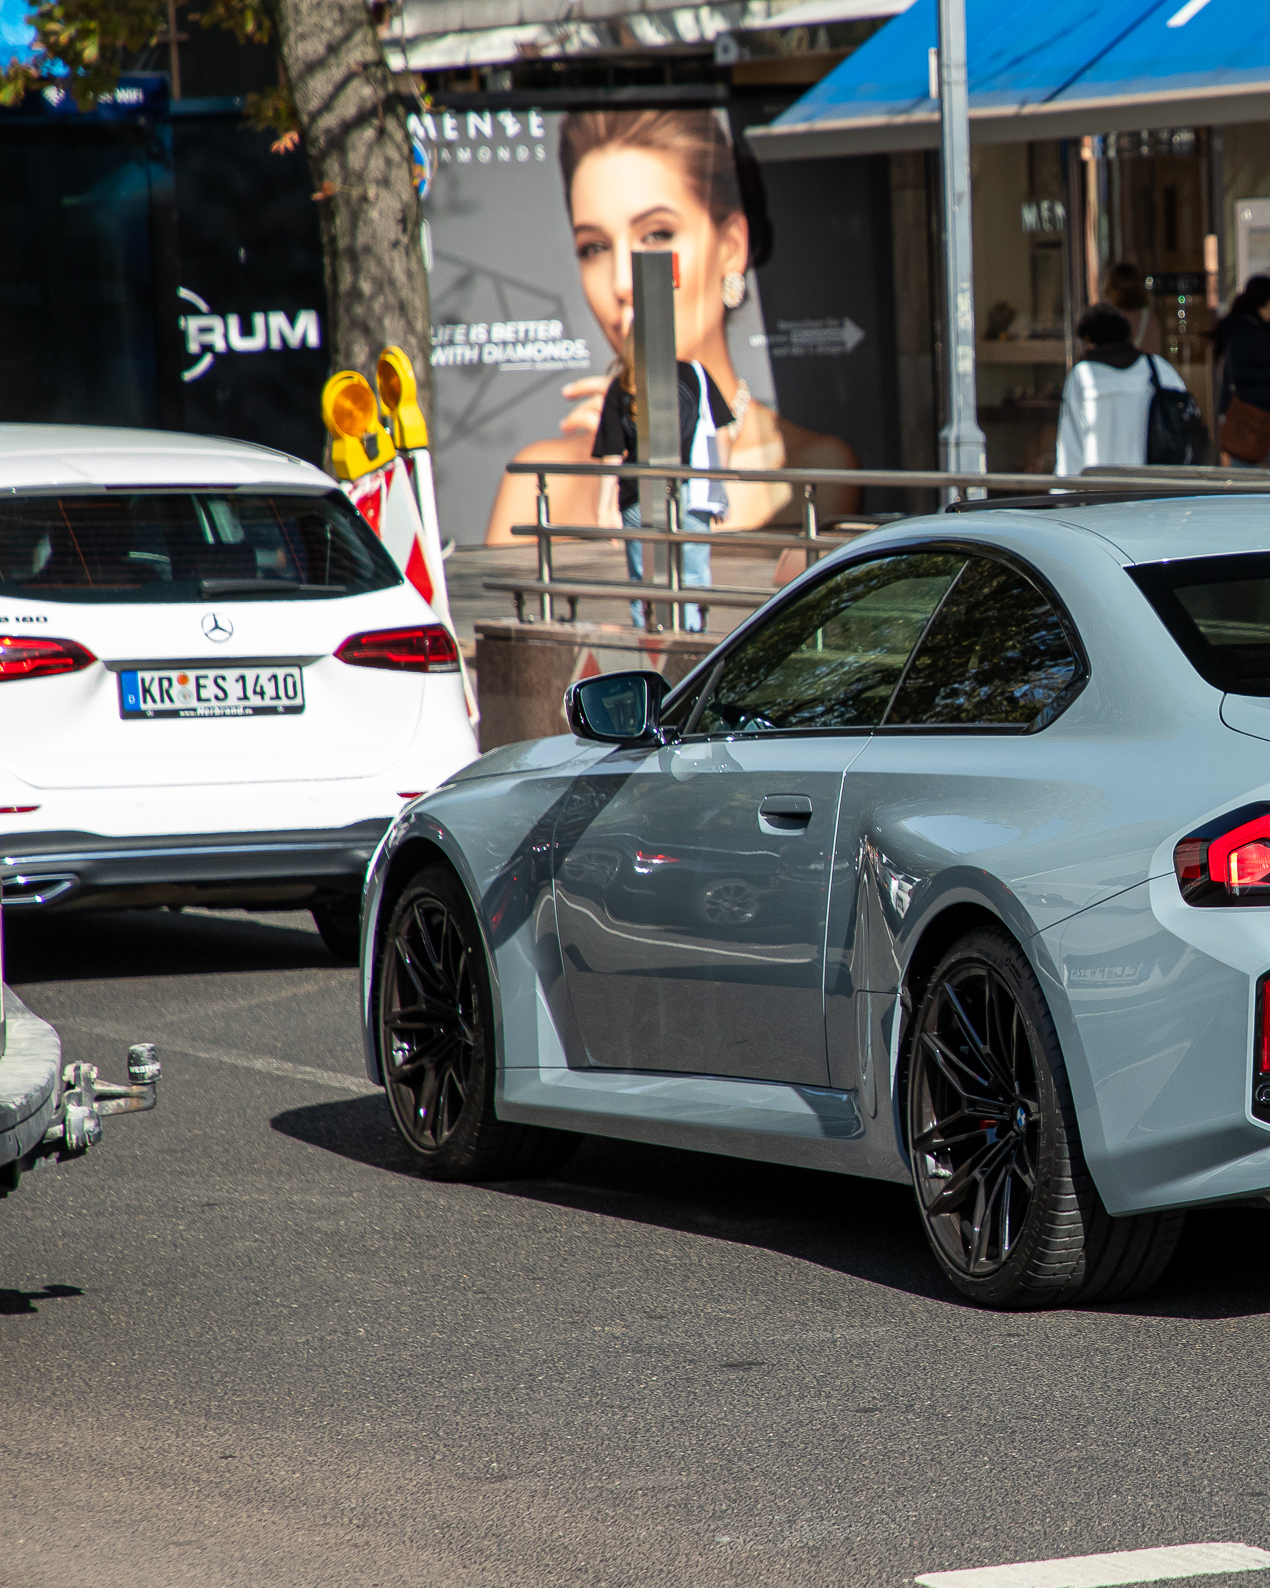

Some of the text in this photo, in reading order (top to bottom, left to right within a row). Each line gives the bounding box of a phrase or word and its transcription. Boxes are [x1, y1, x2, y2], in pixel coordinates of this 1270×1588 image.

[428, 143, 547, 164] IAMONDS
[178, 308, 321, 355] RUM
[468, 322, 489, 344] IS
[490, 319, 564, 343] BETTER
[429, 343, 479, 367] WITH
[140, 676, 175, 705] KR
[195, 674, 229, 703] ES
[235, 673, 299, 702] 1410
